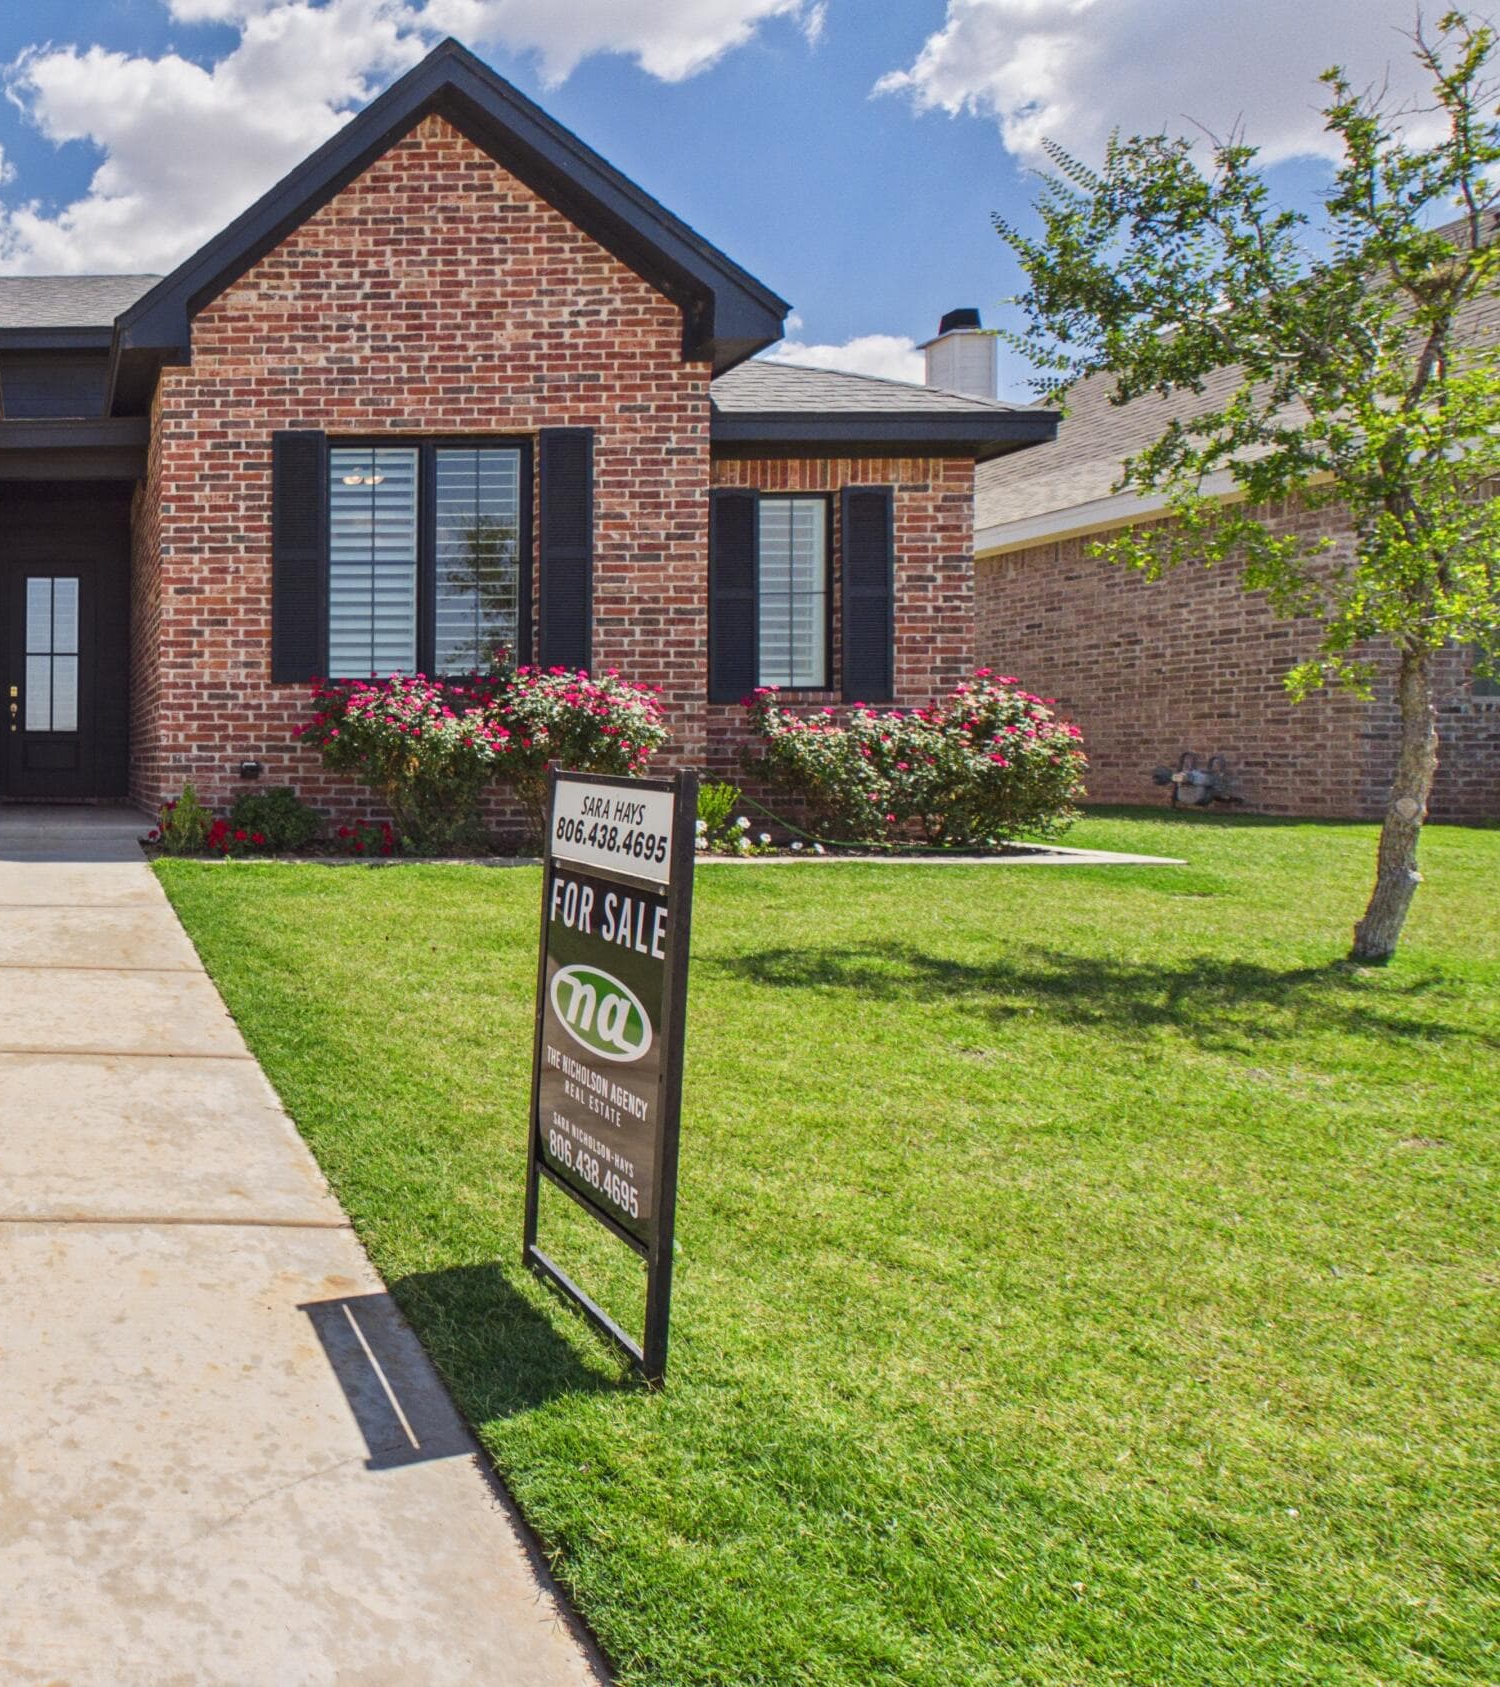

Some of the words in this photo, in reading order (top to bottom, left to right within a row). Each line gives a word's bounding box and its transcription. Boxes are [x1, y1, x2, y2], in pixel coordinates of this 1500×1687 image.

[556, 817, 668, 863] 806.438.4695
[581, 796, 609, 817] SARA
[614, 801, 646, 825] HAYS
[551, 878, 593, 934] FOR
[602, 892, 668, 959] SALE
[560, 974, 636, 1055] na
[547, 1046, 561, 1069] THE
[562, 1057, 608, 1099] NICHOLSON
[610, 1083, 648, 1122] AGENCY
[565, 1081, 585, 1105] REAL
[589, 1098, 621, 1128] ESTATE
[550, 1129, 639, 1219] 806.438.4695
[553, 1112, 570, 1132] SARA
[572, 1124, 634, 1178] NICHOLSON-HAYS
